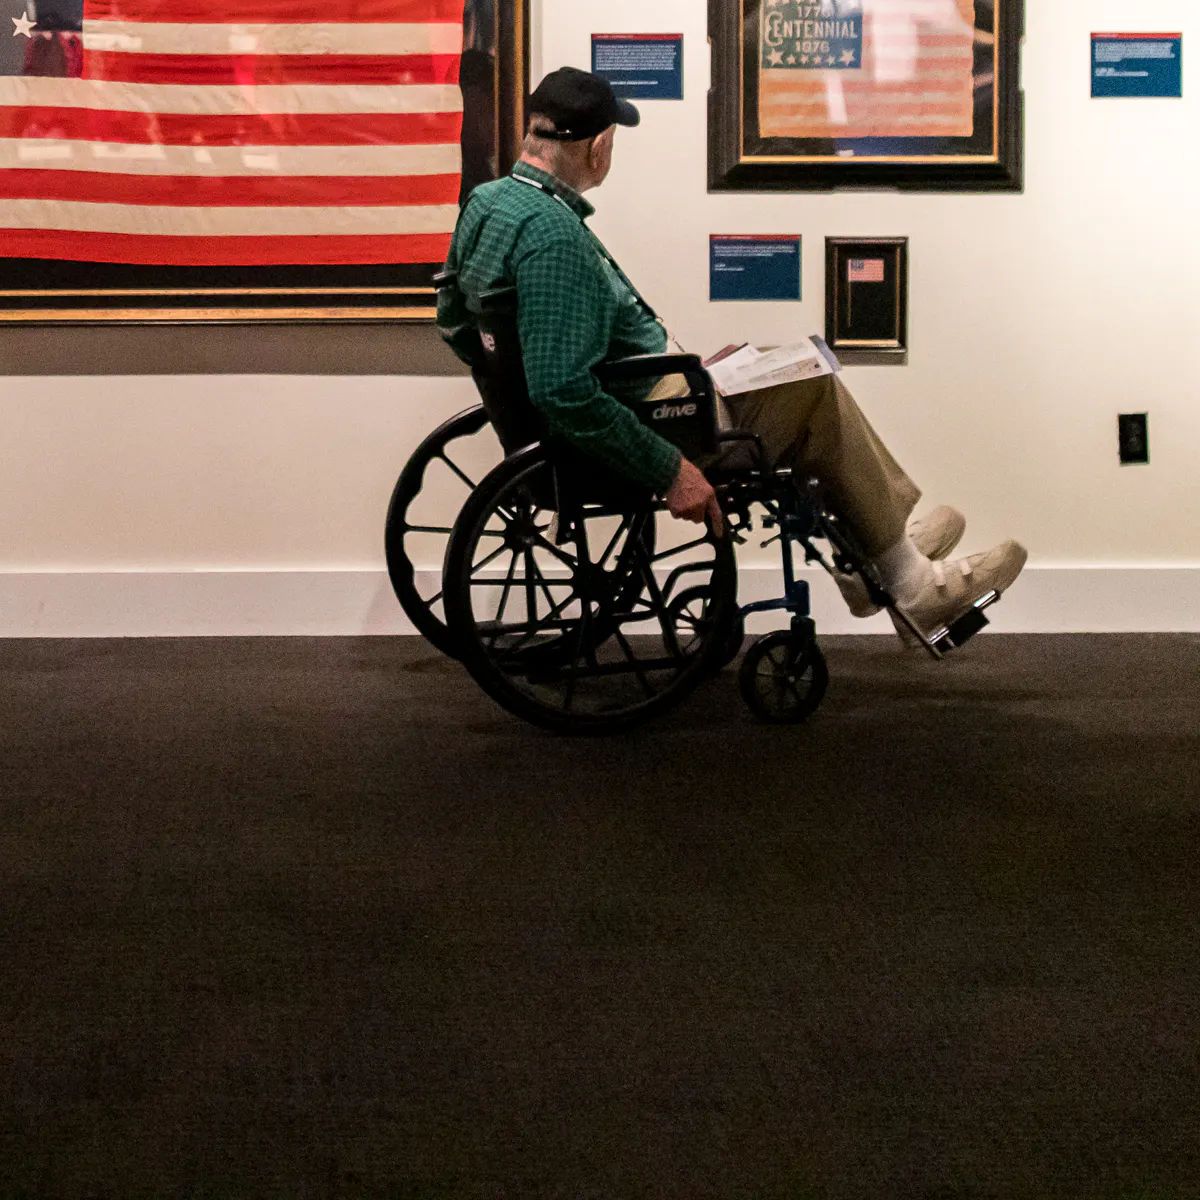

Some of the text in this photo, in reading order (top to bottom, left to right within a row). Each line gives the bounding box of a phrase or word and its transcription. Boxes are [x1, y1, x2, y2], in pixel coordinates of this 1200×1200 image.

[764, 10, 858, 47] CENTENNIAL
[795, 41, 830, 55] 1876
[652, 403, 697, 419] drive
